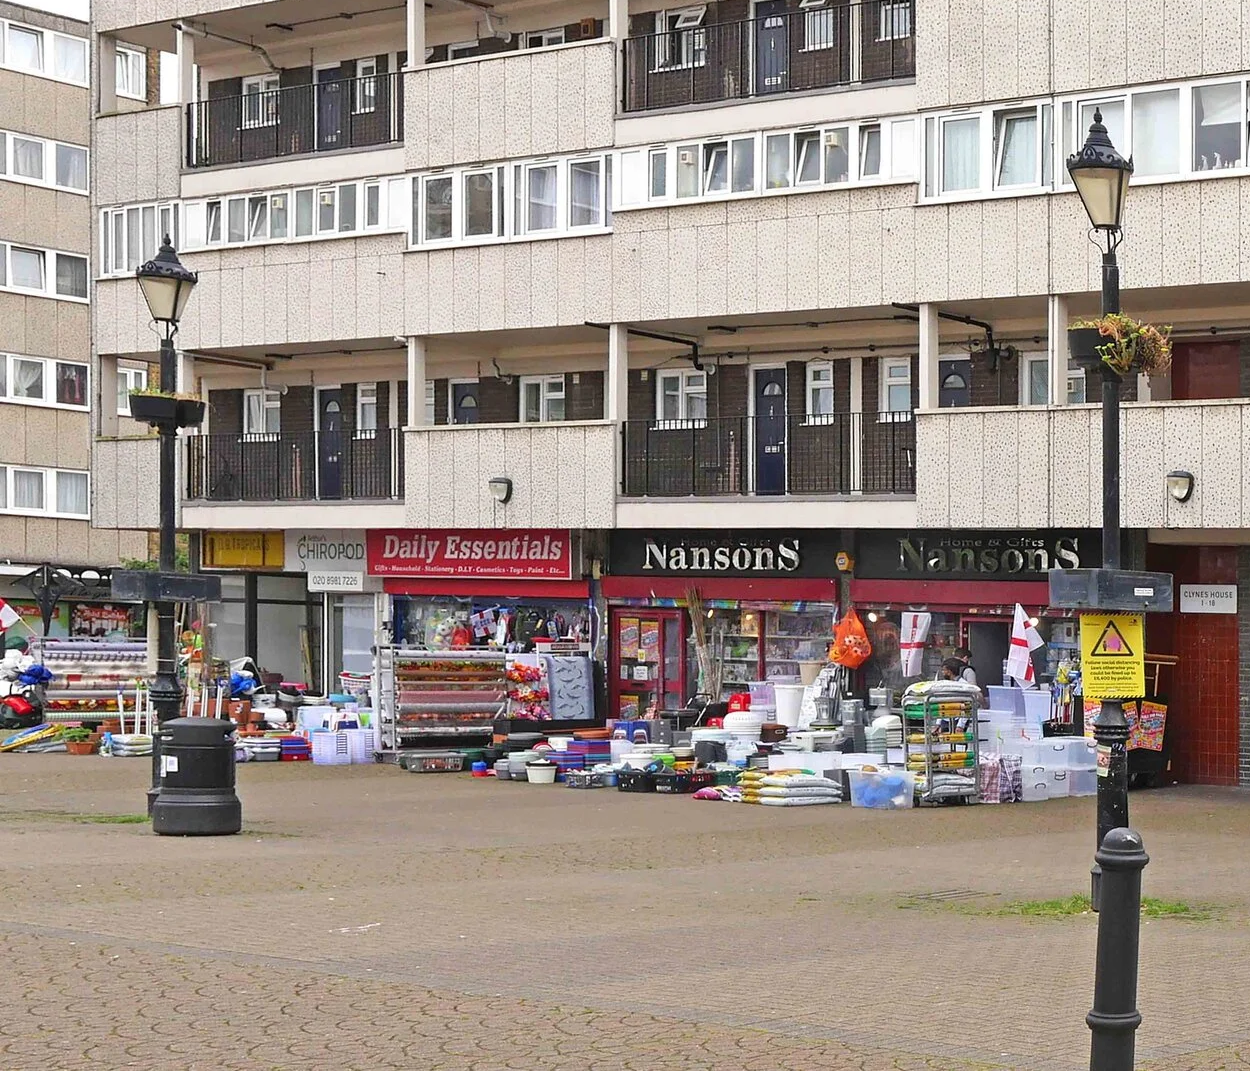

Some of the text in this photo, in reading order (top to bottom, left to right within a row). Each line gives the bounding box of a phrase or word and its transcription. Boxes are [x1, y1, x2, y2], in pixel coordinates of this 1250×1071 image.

[940, 537, 982, 546] Home
[383, 534, 562, 564] Daily Essentials
[312, 576, 358, 586] 020 8981 7226
